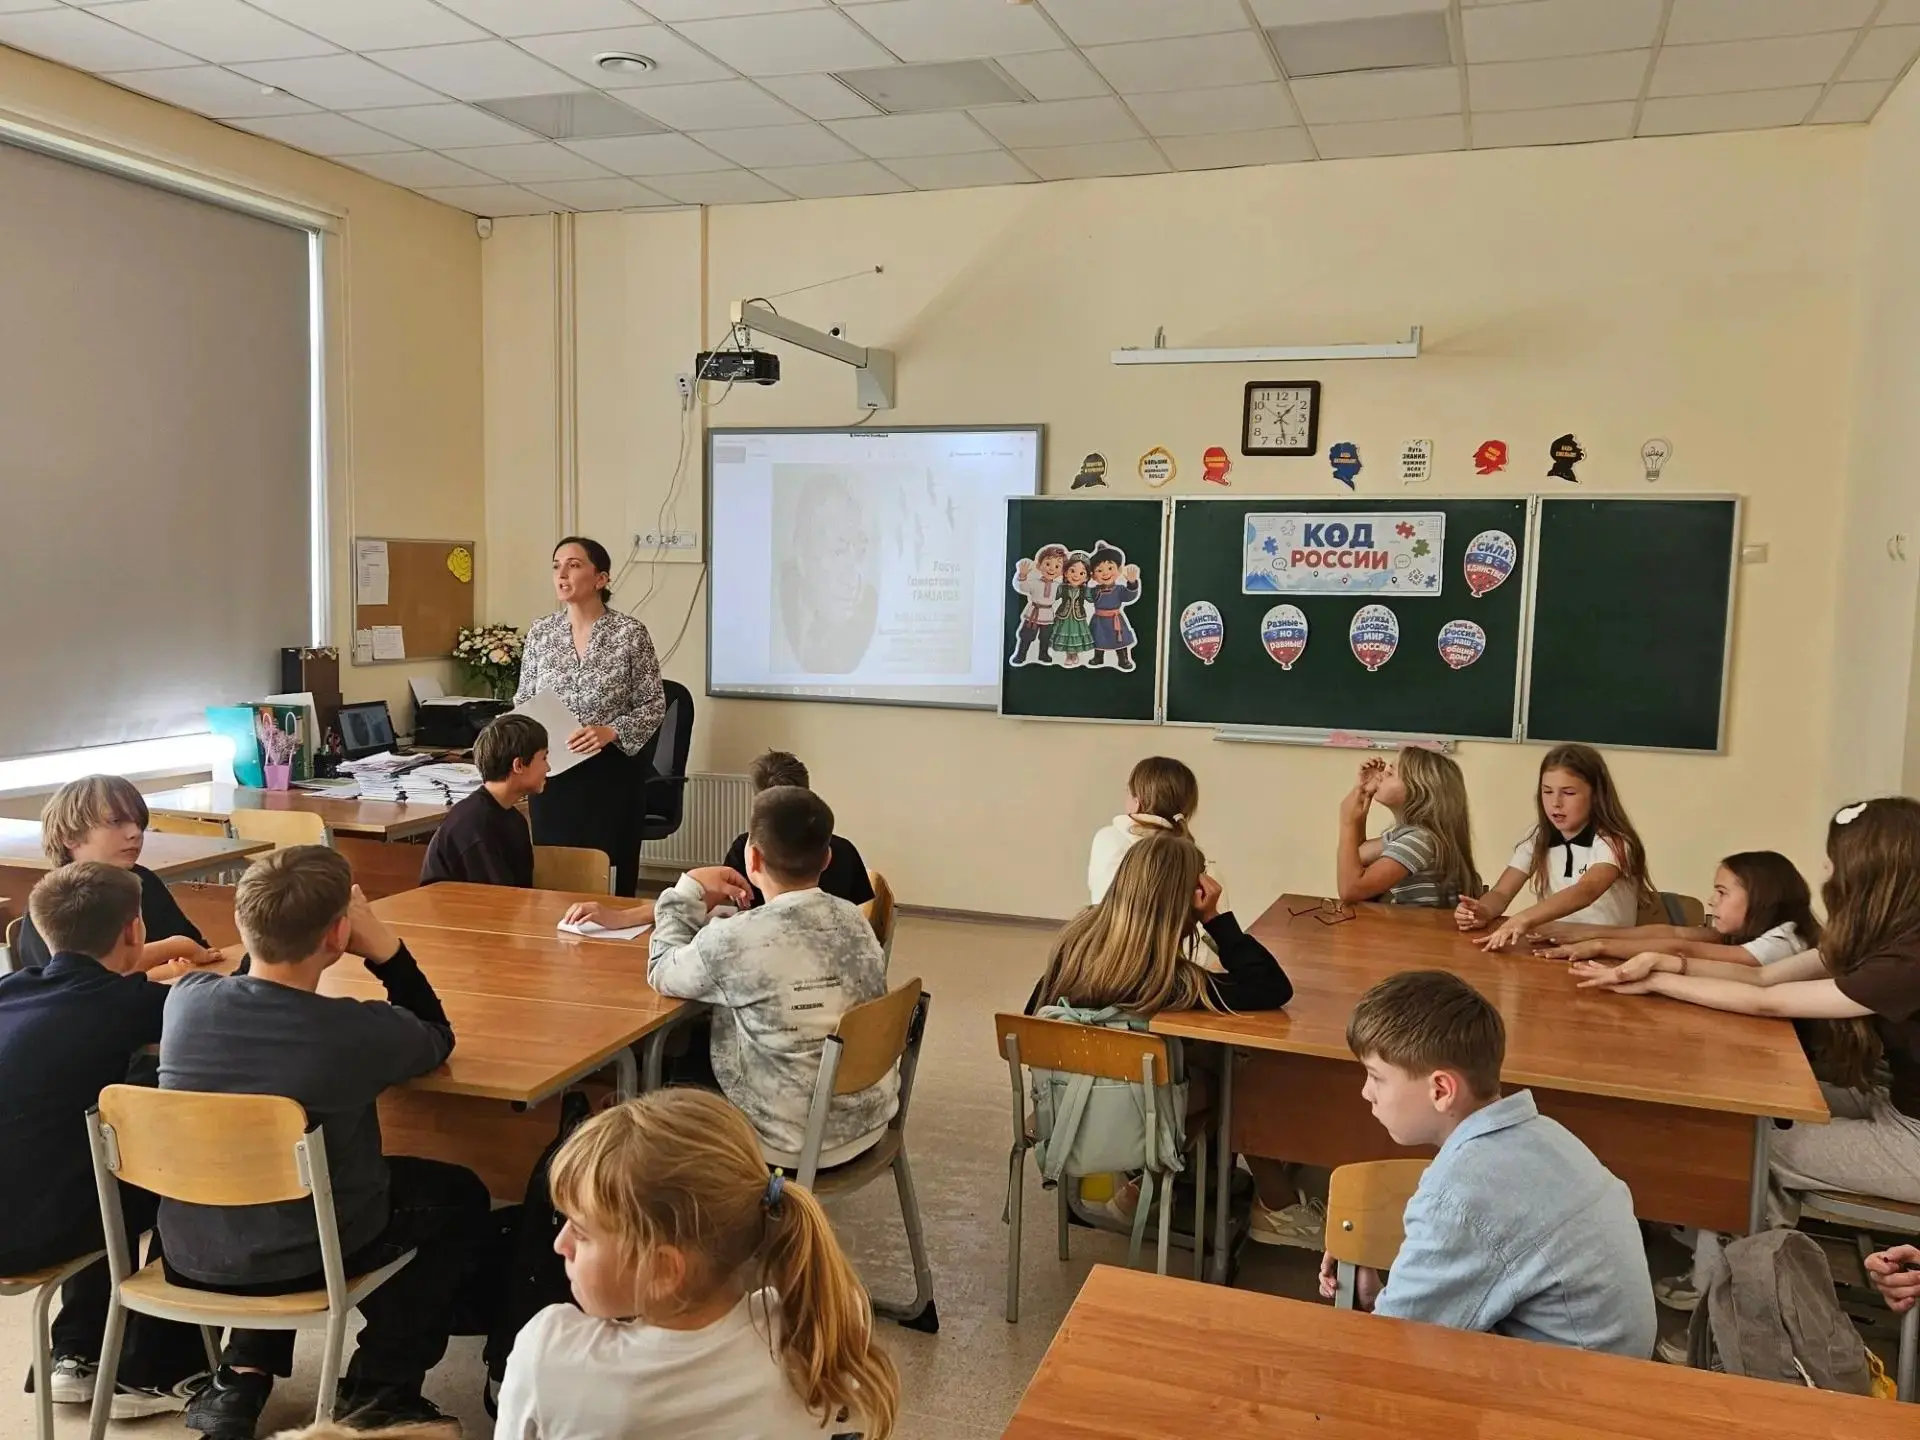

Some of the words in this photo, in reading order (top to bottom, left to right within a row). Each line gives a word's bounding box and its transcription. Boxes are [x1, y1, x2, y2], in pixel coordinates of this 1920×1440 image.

[1262, 391, 1270, 401] 11
[1277, 391, 1289, 401] 12
[1254, 401, 1265, 410] 10
[1300, 400, 1307, 410] 2
[1255, 414, 1262, 423] 9
[1299, 414, 1307, 423] 3
[1254, 427, 1261, 436] 8
[1298, 427, 1306, 437] 4
[1261, 436, 1269, 445] 7
[1275, 436, 1283, 445] 6
[1290, 436, 1298, 445] 5
[1303, 522, 1375, 549] КОД
[1477, 542, 1510, 560] СИЛА
[1290, 550, 1389, 570] РОССИИ
[1363, 632, 1385, 641] МИР
